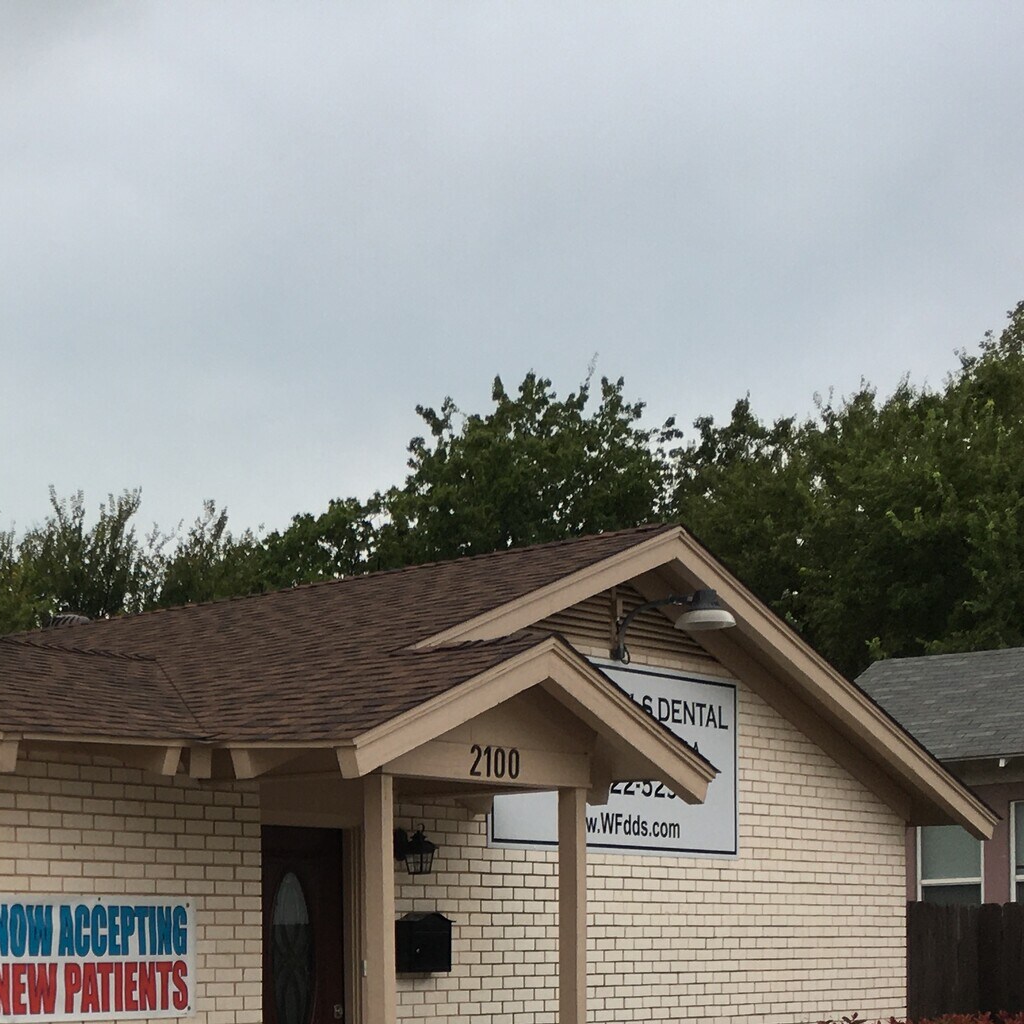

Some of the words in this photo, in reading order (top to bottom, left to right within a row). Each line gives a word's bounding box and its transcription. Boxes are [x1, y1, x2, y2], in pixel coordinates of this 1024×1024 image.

[657, 697, 729, 730] DENTAL
[469, 744, 520, 779] 2100
[586, 812, 680, 838] w.WFdds.com
[58, 904, 188, 957] ACCEPTING
[64, 960, 189, 1014] PATIENTS
